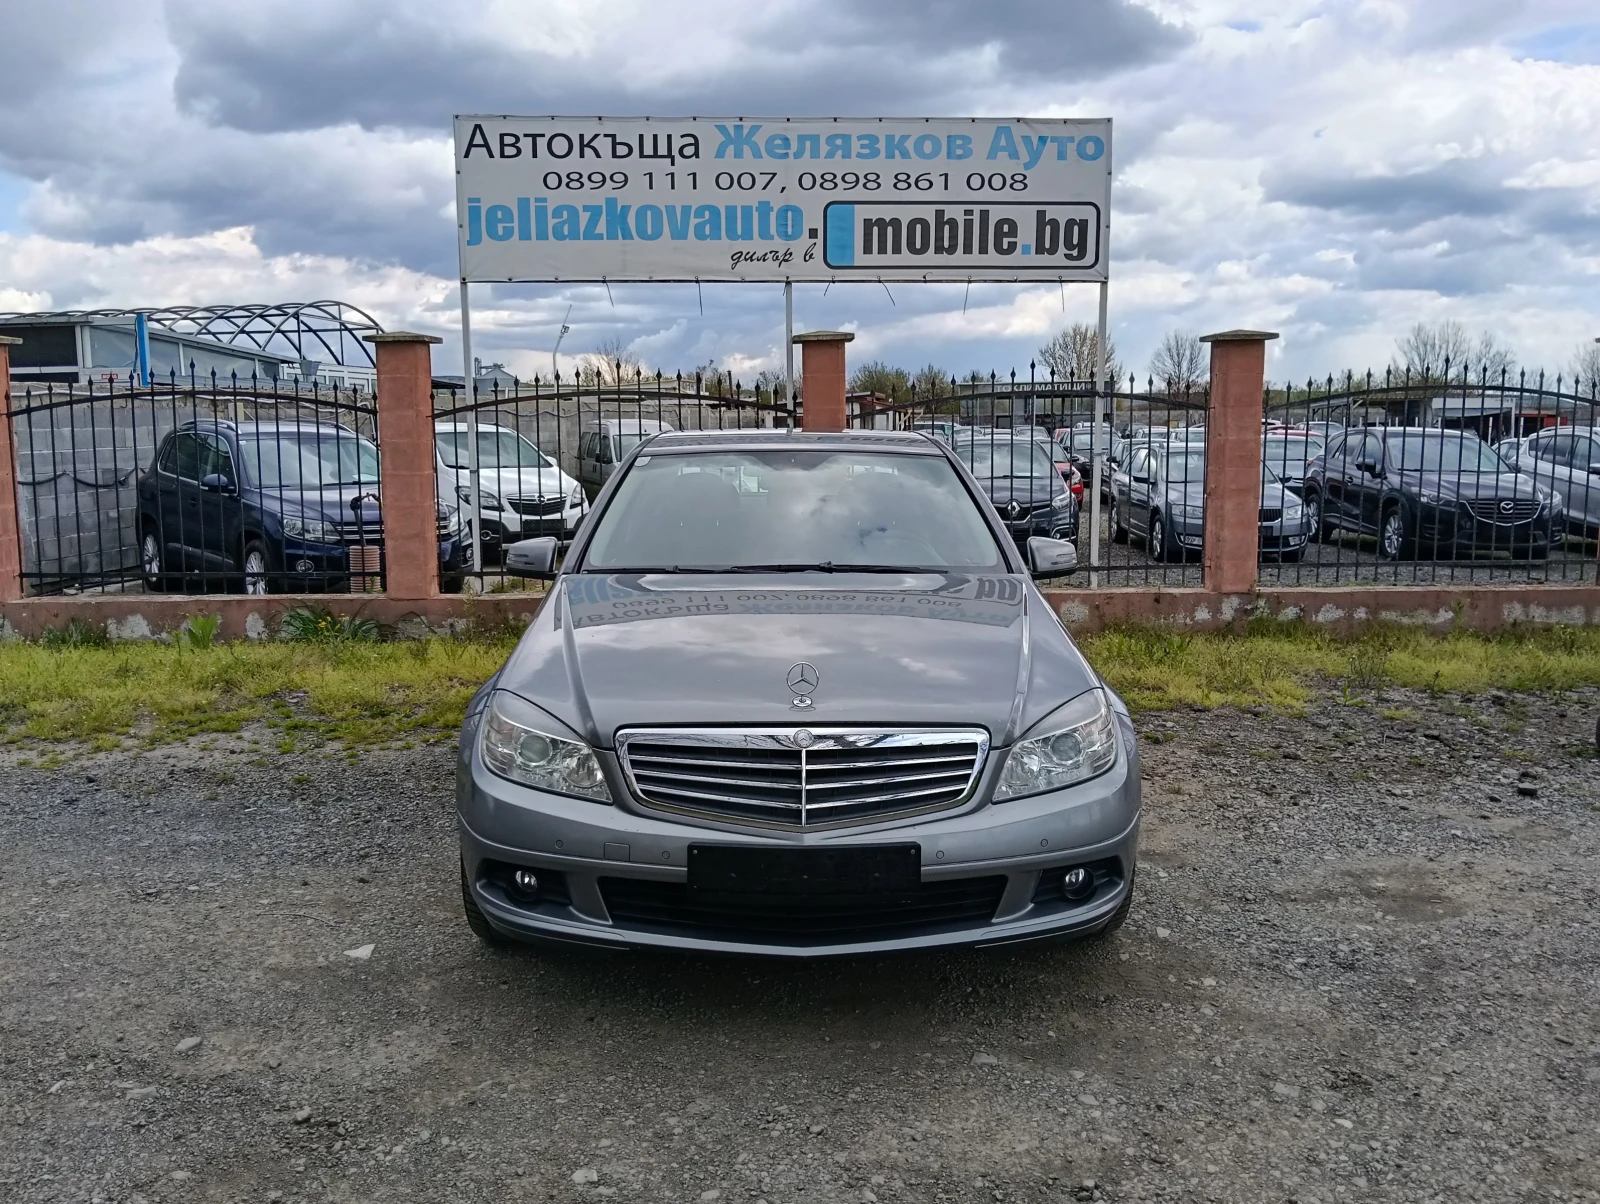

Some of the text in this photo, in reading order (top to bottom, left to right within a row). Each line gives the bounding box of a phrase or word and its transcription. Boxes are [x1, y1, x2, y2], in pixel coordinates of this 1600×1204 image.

[463, 123, 1105, 171] Автокъща Желязков Ауто
[542, 171, 1029, 194] 0899 111 007, 0898 861 008
[466, 196, 1089, 261] jeliazkovauto. mobile.bg
[730, 241, 817, 270] дилър в
